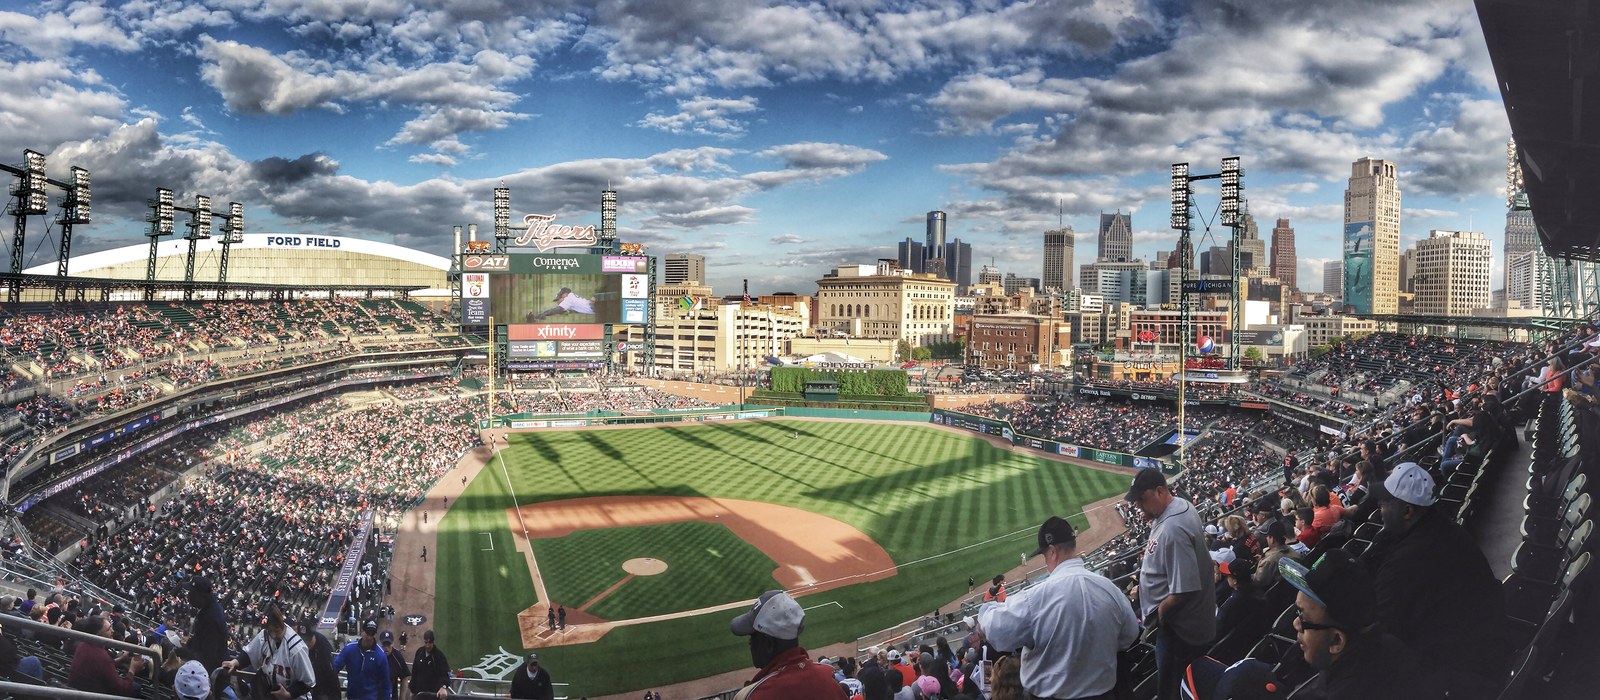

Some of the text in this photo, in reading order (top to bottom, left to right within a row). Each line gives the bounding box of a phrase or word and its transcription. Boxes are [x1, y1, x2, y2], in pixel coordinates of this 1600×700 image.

[515, 213, 597, 252] Tigers
[267, 236, 341, 248] FORD FIELD
[482, 257, 509, 267] ATI
[1198, 280, 1232, 291] MICHIGAN
[820, 361, 875, 369] CHEVROLET
[1061, 447, 1076, 455] meijer
[54, 476, 76, 494] DETROIT
[82, 466, 97, 479] TEXAS
[344, 549, 360, 571] DETROIT
[336, 572, 352, 592] TIGERS
